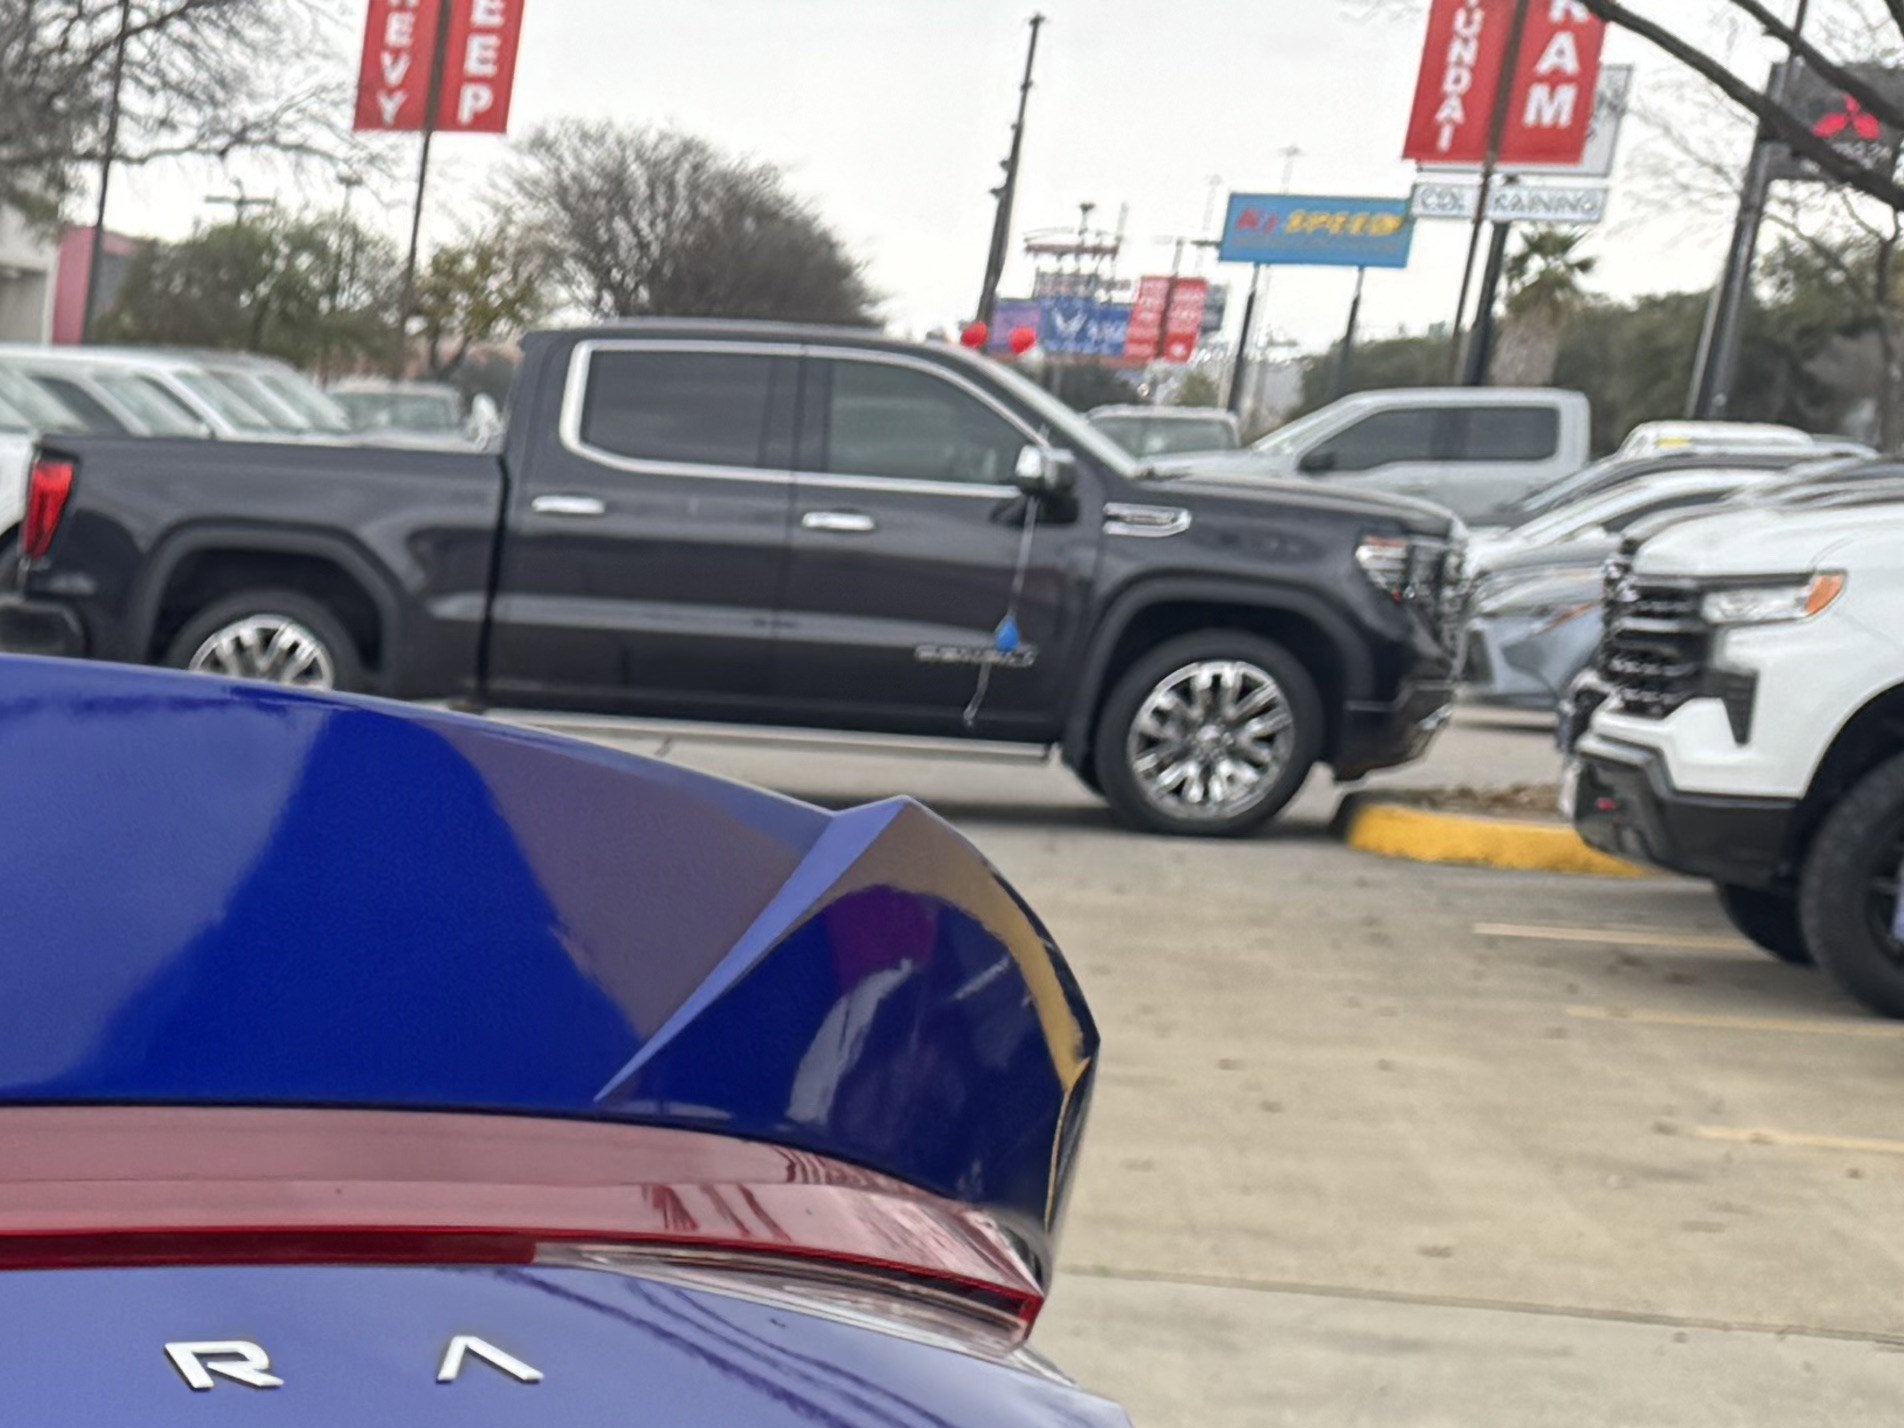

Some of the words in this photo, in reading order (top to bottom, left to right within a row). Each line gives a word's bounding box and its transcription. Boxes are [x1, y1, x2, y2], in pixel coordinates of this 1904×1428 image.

[376, 0, 419, 126] EVY
[458, 0, 505, 125] EEP
[1435, 0, 1485, 152] UNDAI
